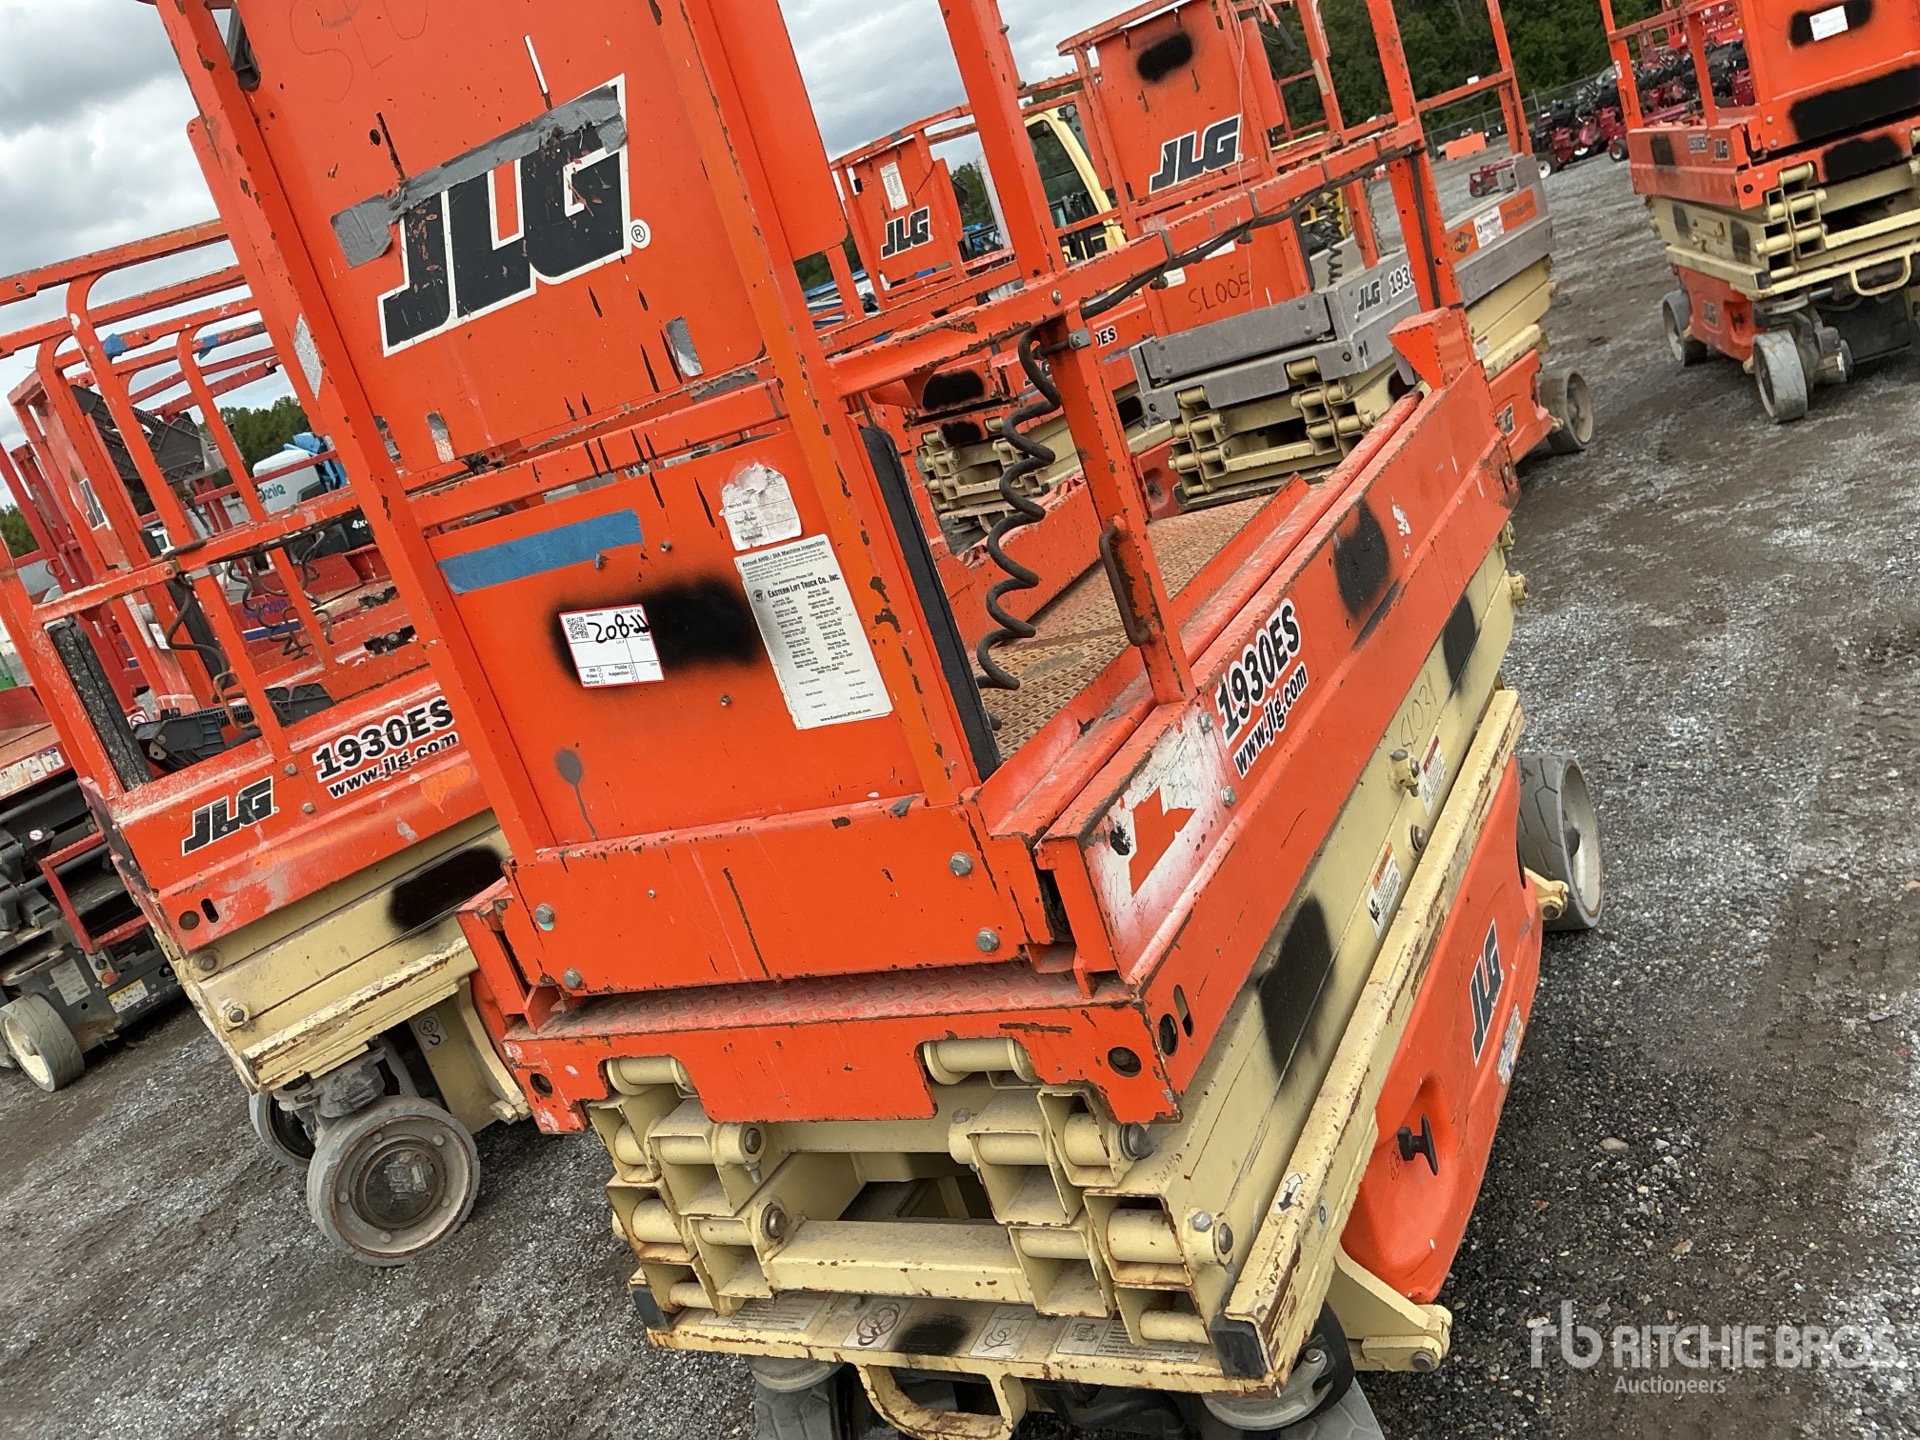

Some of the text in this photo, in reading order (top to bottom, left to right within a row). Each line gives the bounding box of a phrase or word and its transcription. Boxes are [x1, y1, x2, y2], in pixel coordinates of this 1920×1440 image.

[1149, 114, 1241, 194] JLG
[1714, 139, 1728, 159] JLG
[377, 74, 631, 357] JLG
[881, 206, 930, 260] JLG
[1188, 271, 1251, 315] SL005
[1357, 265, 1415, 312] JLG 193
[781, 547, 800, 556] Machine
[801, 540, 826, 551] Inspection
[767, 585, 790, 598] EASTERN
[790, 583, 801, 592] LIFT
[800, 578, 818, 589] TRUCK
[1217, 604, 1300, 742] 1930ES
[315, 698, 454, 779] 1930ES
[1234, 664, 1308, 778] www.jlg.com
[329, 732, 457, 798] www.jlg.com
[182, 775, 273, 856] JLG
[1470, 917, 1503, 1067] JLG
